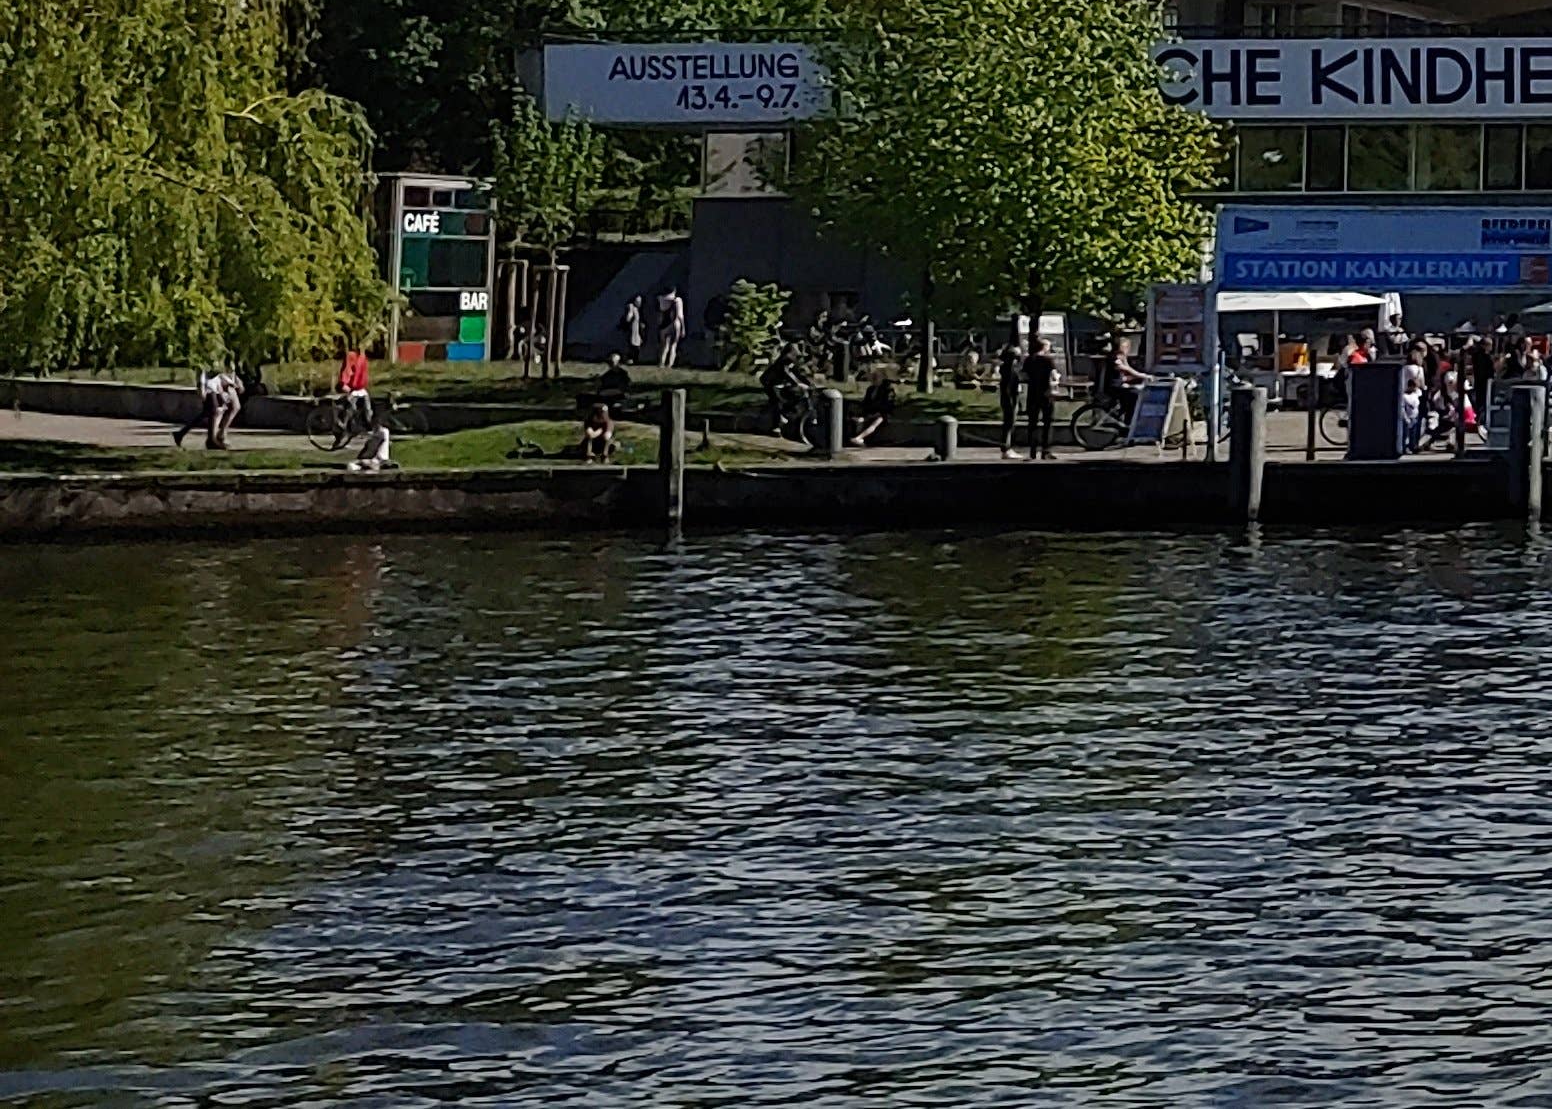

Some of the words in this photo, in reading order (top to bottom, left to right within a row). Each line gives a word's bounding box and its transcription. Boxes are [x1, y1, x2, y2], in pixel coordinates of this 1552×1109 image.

[609, 52, 800, 81] AUSSTELLUNG
[403, 211, 440, 234] CAFÉ
[1235, 260, 1337, 279] STATION
[1345, 259, 1509, 279] KANZLERAMT
[460, 292, 489, 311] BAR
